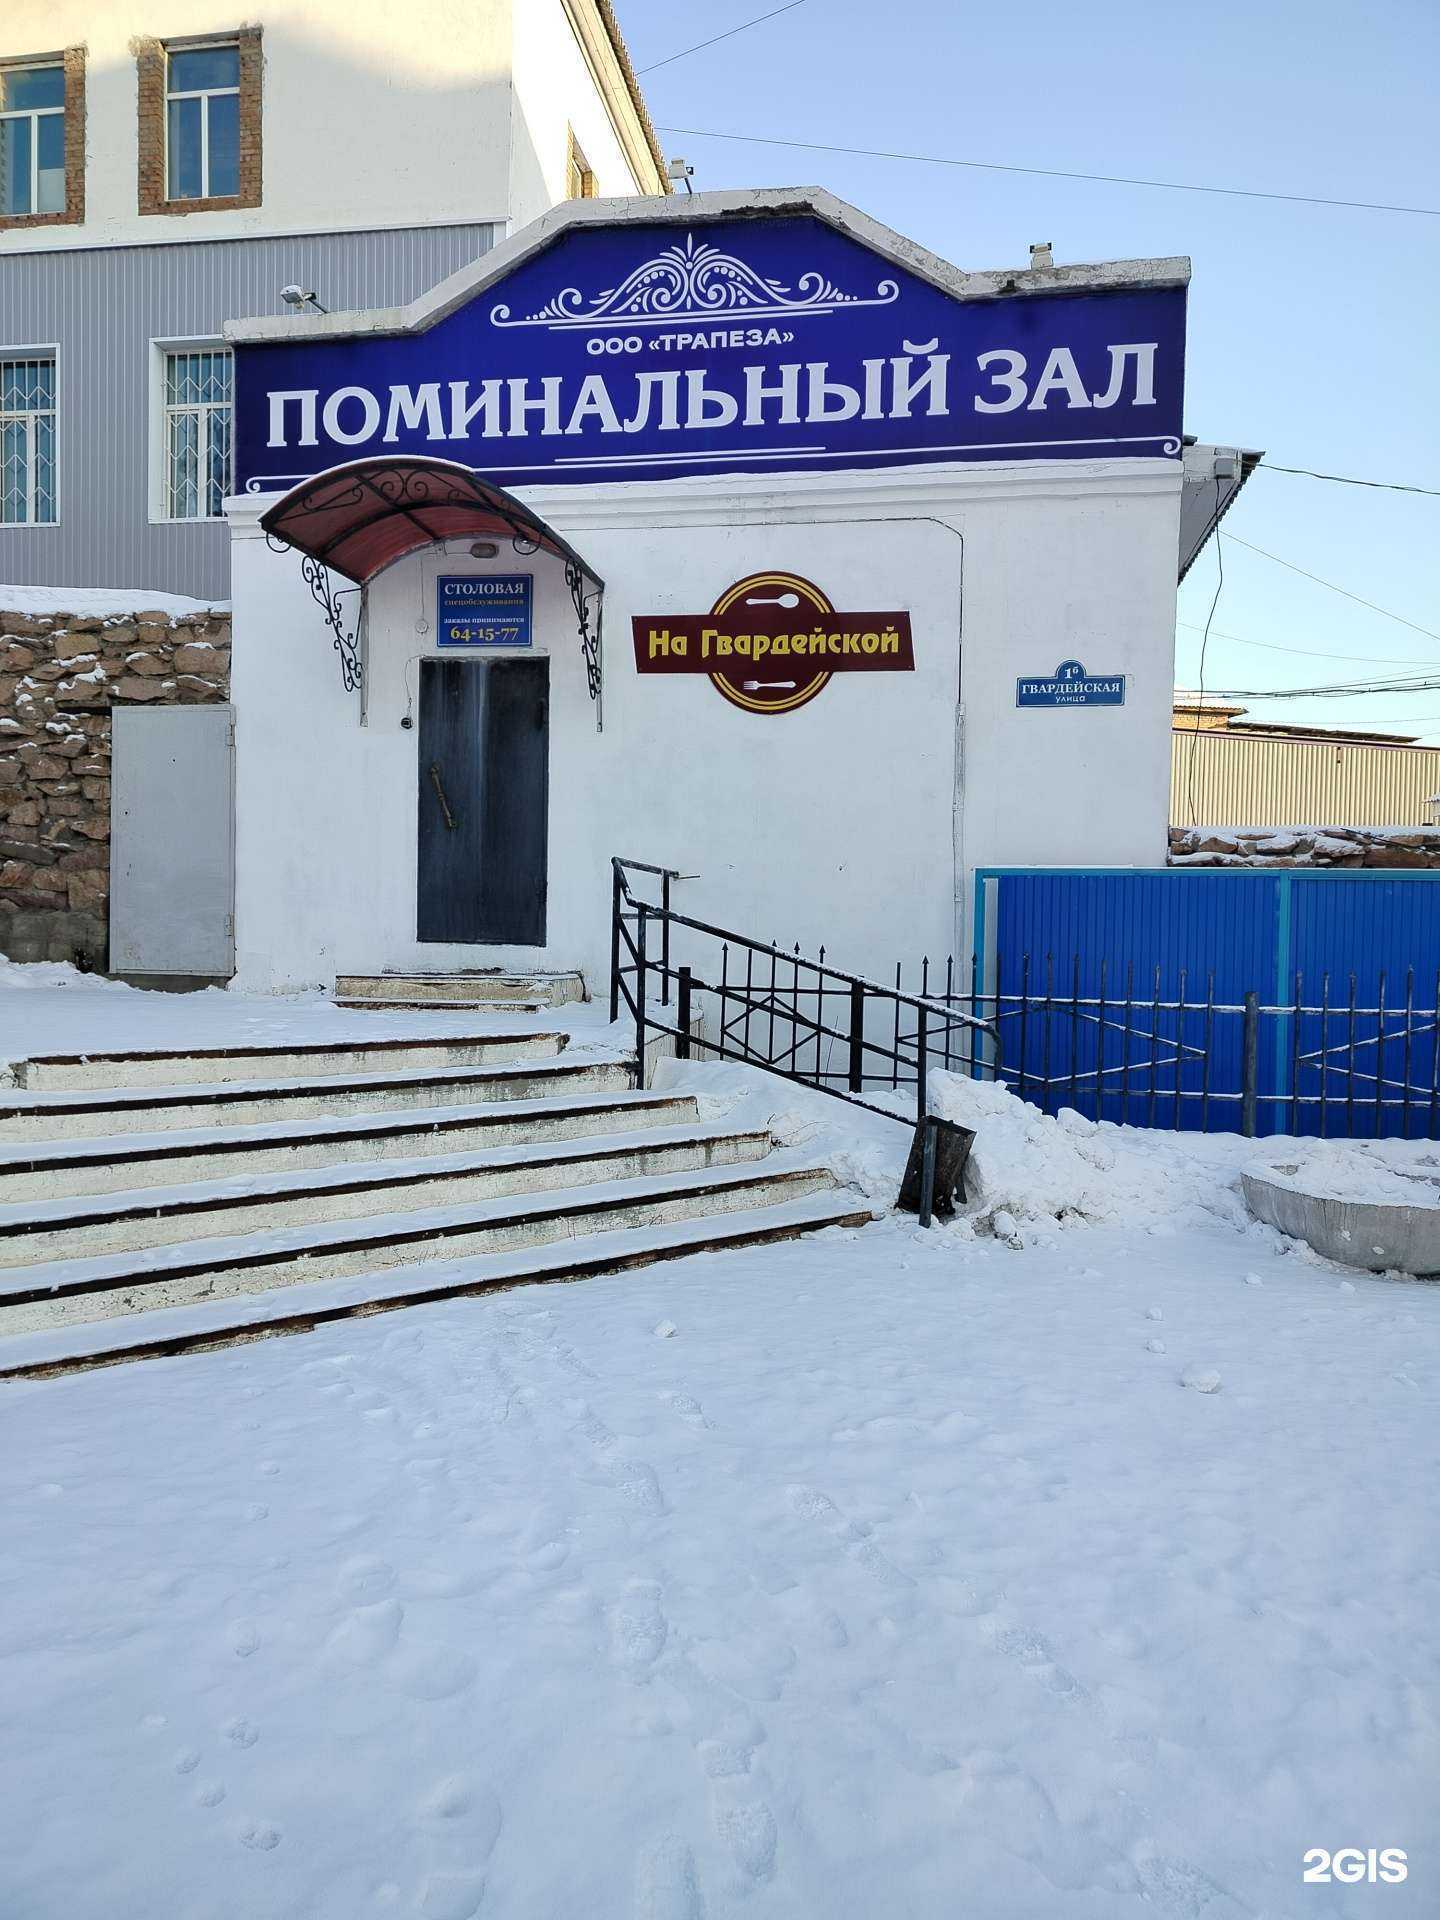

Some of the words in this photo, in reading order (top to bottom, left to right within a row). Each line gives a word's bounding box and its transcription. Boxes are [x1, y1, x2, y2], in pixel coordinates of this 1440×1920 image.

[586, 336, 643, 355] ООО
[648, 328, 795, 351] «ТРАПЕЗА»
[266, 337, 951, 448] ПОМИНАЛЬНЫЙ
[974, 342, 1158, 414] ЗАЛ
[444, 583, 524, 595] СТОЛОВАЯ
[444, 616, 471, 624] заказы
[472, 616, 525, 625] принимаются
[450, 626, 519, 642] 64-15-77
[649, 630, 688, 659] На
[702, 626, 899, 661] Гвардейской
[1022, 681, 1121, 695] ГВАРДЕЙСКАЯ
[1055, 695, 1086, 703] улица
